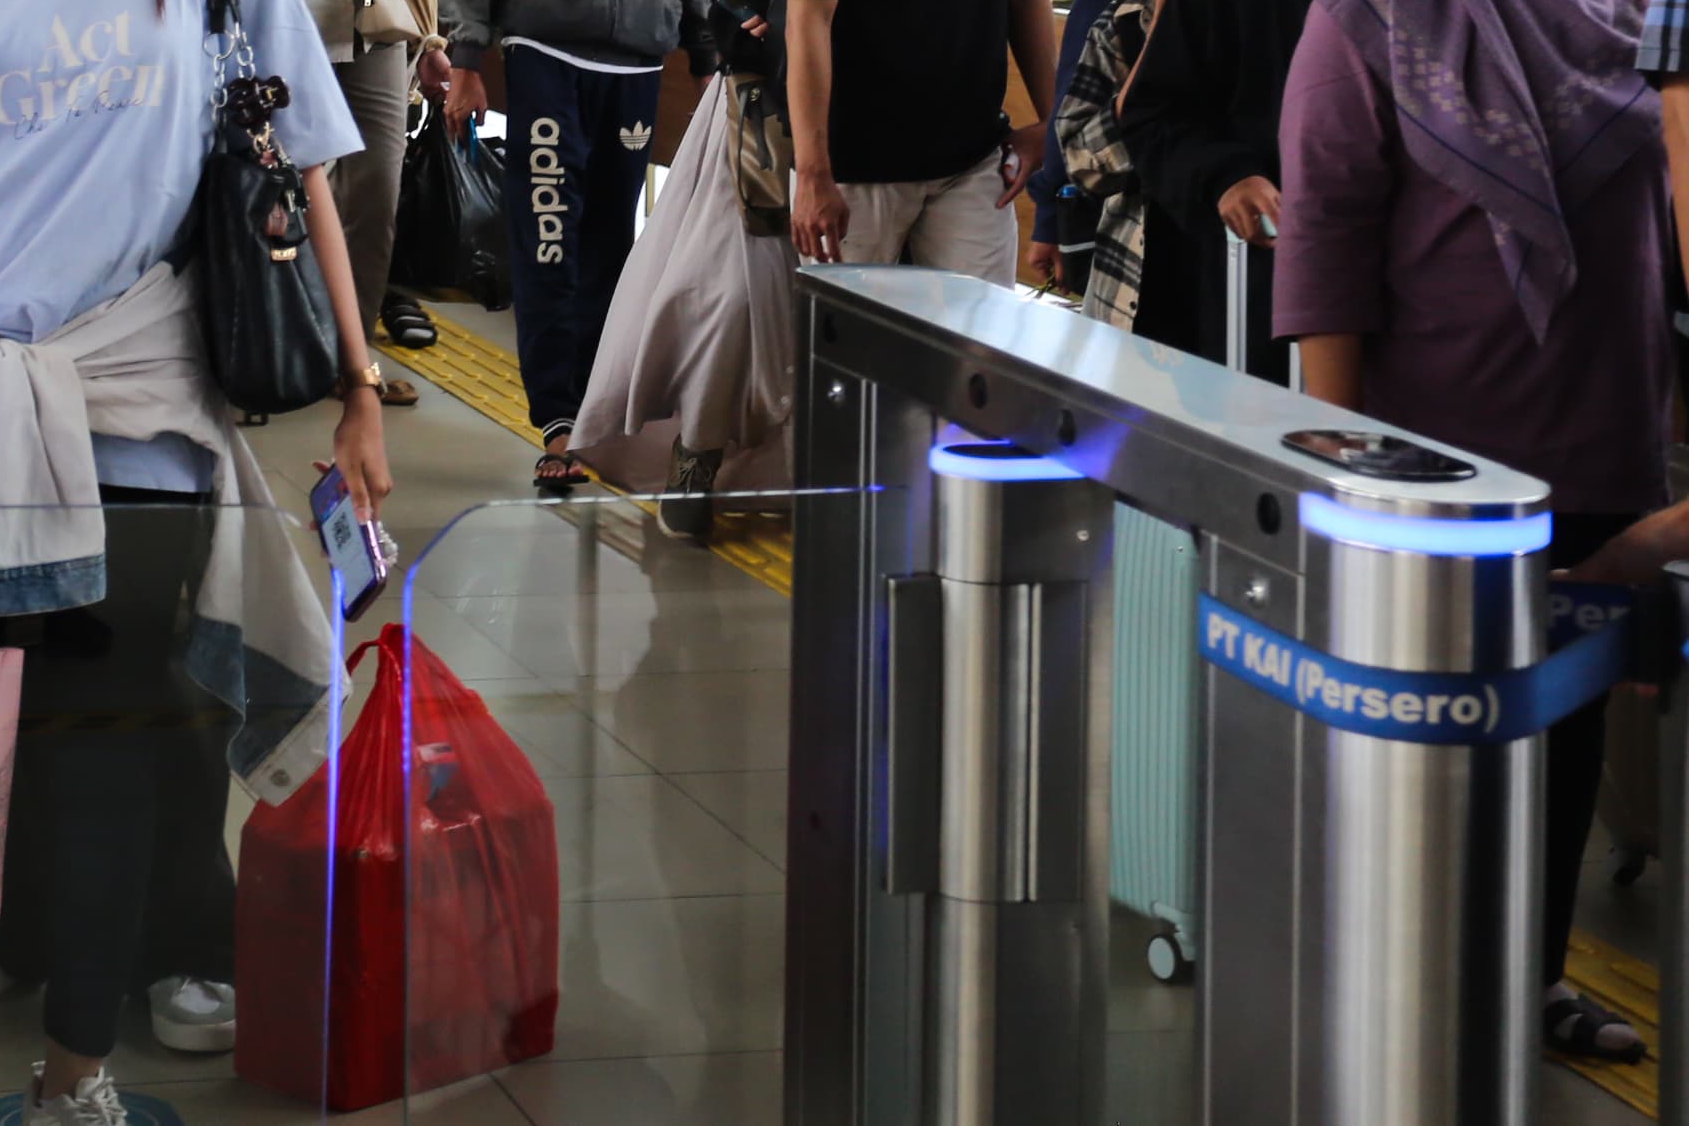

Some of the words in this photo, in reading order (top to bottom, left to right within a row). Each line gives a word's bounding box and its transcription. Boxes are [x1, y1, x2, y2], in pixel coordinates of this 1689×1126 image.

[36, 9, 134, 74] Act
[529, 116, 569, 265] adidas
[1206, 611, 1241, 660] PT
[1243, 631, 1292, 688] KAI
[1295, 657, 1499, 734] (Persero)
